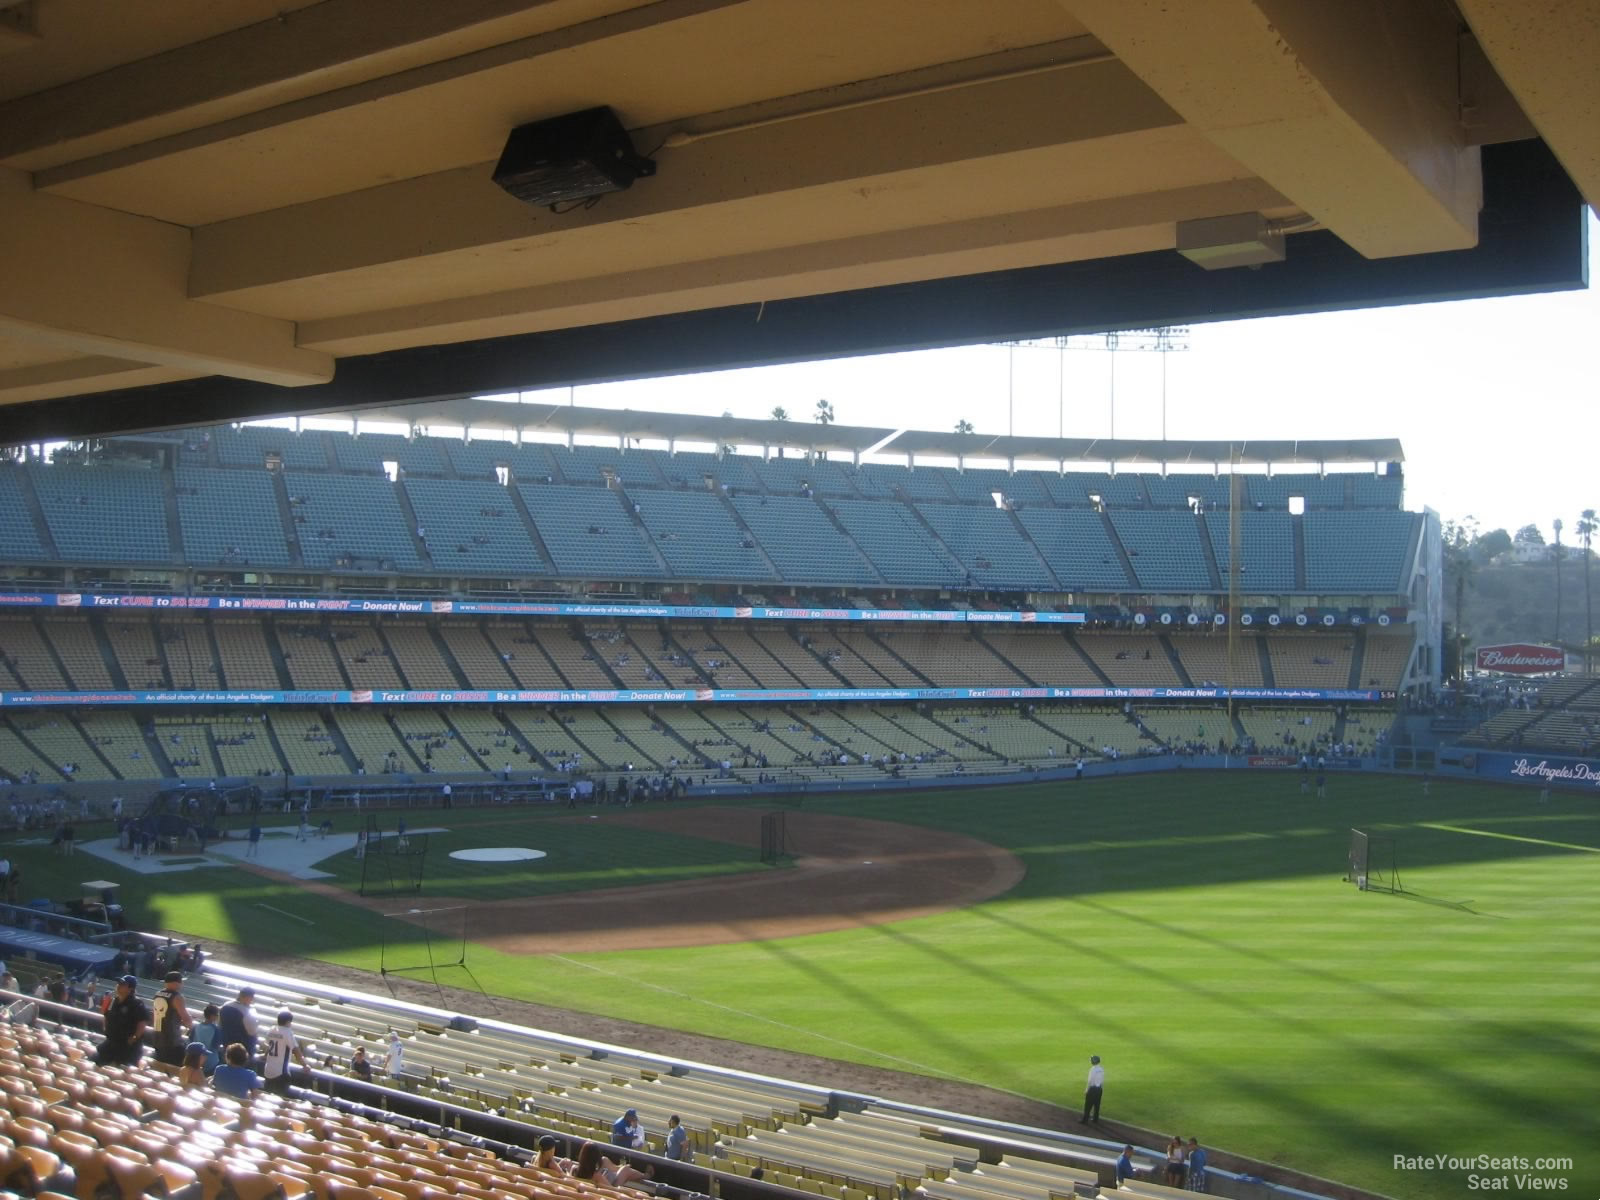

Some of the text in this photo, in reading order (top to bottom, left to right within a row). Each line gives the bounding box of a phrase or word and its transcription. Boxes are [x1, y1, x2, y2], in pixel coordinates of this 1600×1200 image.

[94, 596, 119, 605] Text
[121, 596, 154, 606] CURE
[157, 598, 170, 606] to
[219, 599, 233, 608] Be
[242, 599, 286, 609] WINNER
[288, 600, 297, 609] in
[299, 600, 316, 609] the
[317, 600, 351, 610] FIGHT
[363, 601, 398, 611] Donate
[398, 602, 423, 612] Now!
[765, 609, 784, 617] Text
[812, 610, 820, 618] to
[862, 611, 872, 619] Be
[968, 612, 994, 621] Donate
[994, 612, 1013, 621] Now!
[1480, 651, 1562, 667] Budweiser
[177, 694, 198, 702] charity
[227, 693, 249, 701] Angeles
[250, 693, 274, 701] Dodgers
[381, 692, 405, 701] Text
[440, 693, 452, 701] to
[496, 692, 509, 701] Be
[561, 692, 570, 701] in
[571, 692, 586, 701] the
[631, 691, 663, 700] Donate
[664, 691, 686, 700] Now!
[968, 689, 986, 697] Text
[1054, 689, 1065, 697] Be
[1105, 689, 1113, 697] in
[1114, 689, 1128, 697] the
[1166, 689, 1195, 697] Donate
[1196, 689, 1217, 697] Now!
[1511, 759, 1531, 777] Los
[1529, 761, 1573, 781] Angeles
[268, 1040, 279, 1057] 21
